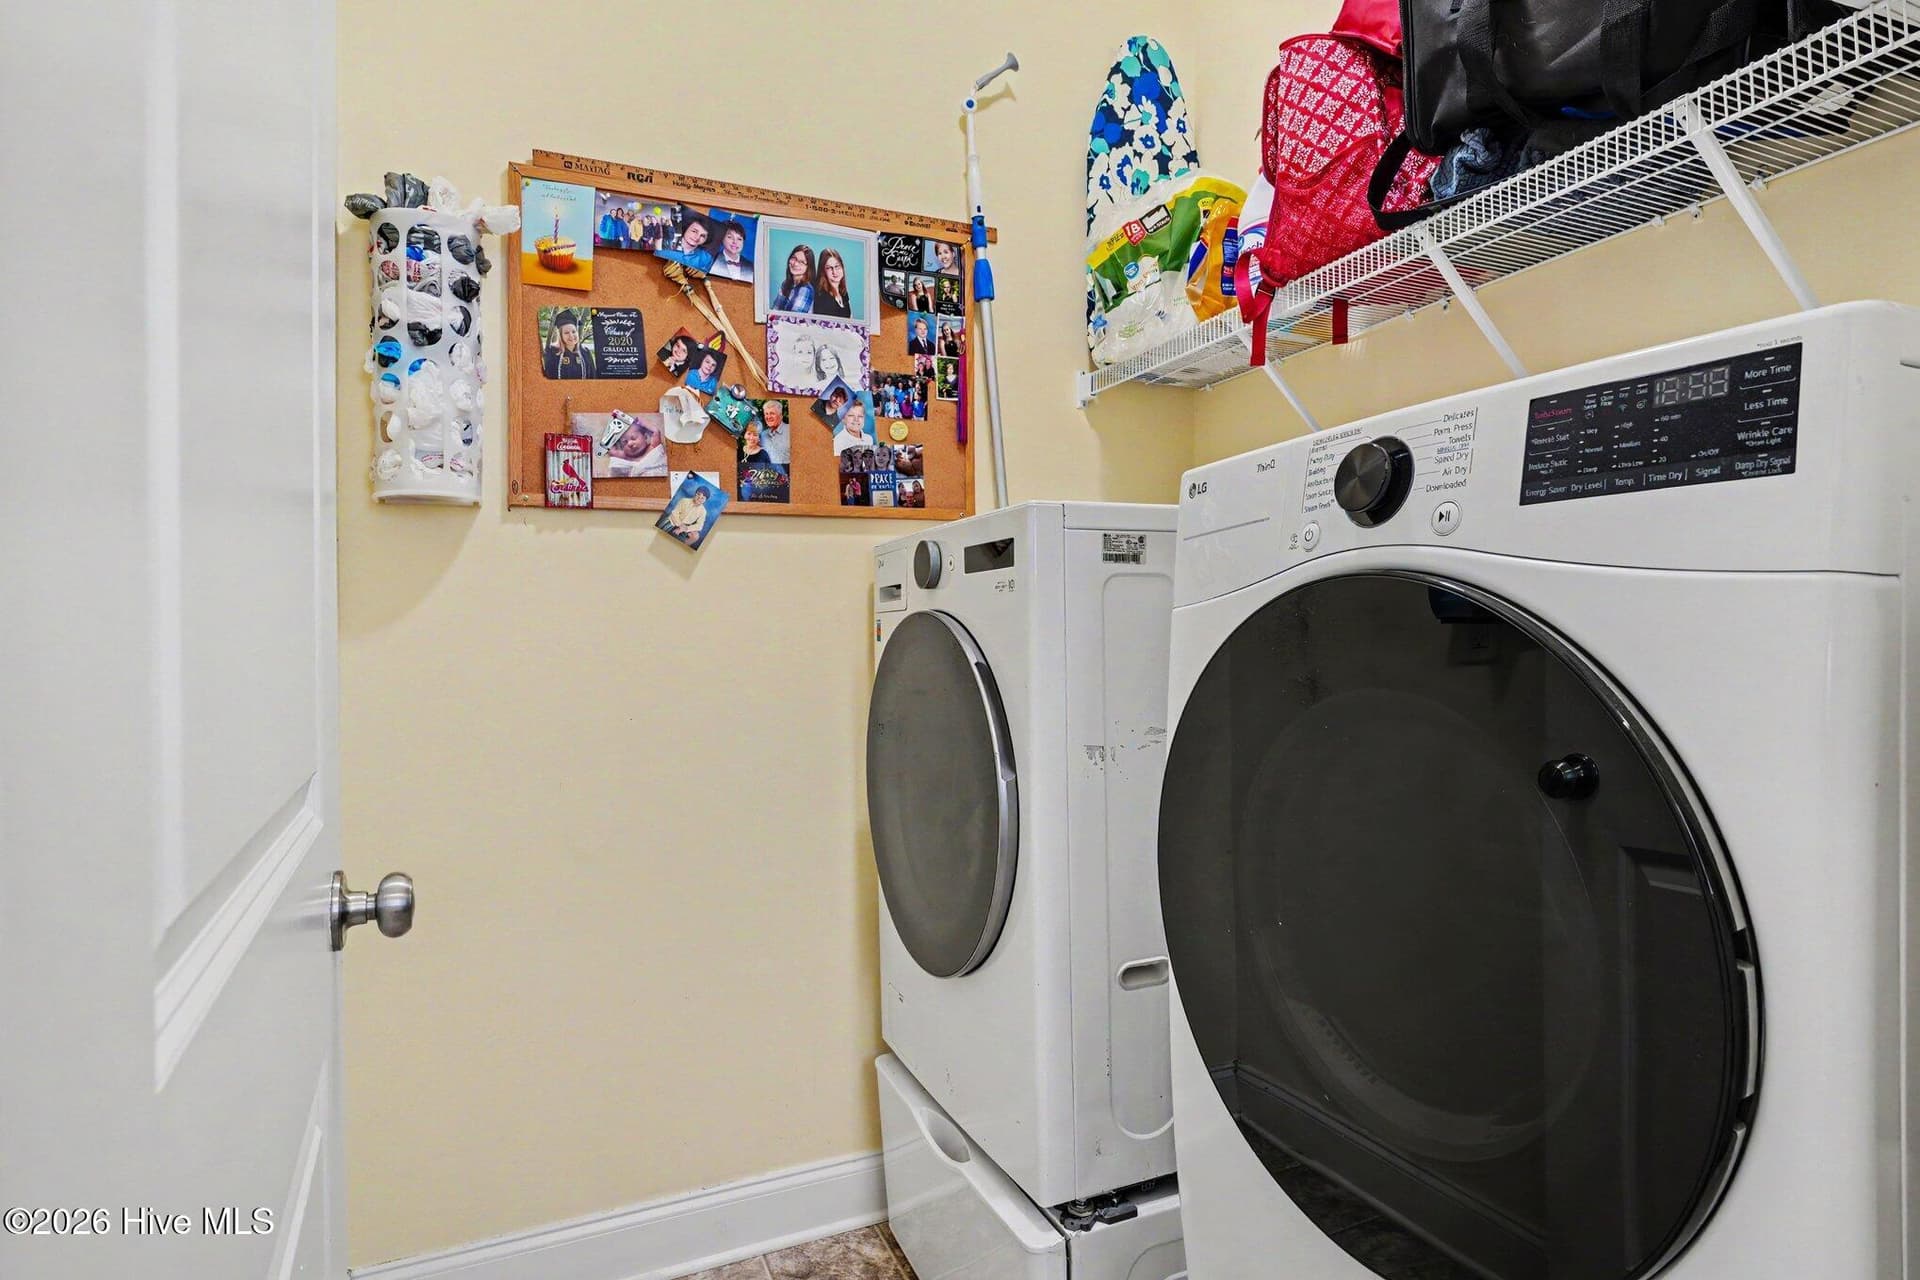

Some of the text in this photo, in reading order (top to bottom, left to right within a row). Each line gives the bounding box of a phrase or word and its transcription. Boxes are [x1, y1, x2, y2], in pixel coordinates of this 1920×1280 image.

[574, 161, 611, 175] MAYTAG
[627, 171, 654, 184] RCA
[608, 336, 633, 346] 2020
[1744, 364, 1792, 379] More Time
[1744, 396, 1789, 411] Less Time
[1443, 410, 1474, 422] Delicates
[1454, 422, 1473, 432] Press
[1736, 426, 1793, 440] Wrinkle Care
[1449, 434, 1472, 445] Towels
[1555, 433, 1571, 443] Start
[1434, 451, 1470, 464] Speed Dry
[1735, 456, 1791, 471] Damp Dry Signal
[1256, 459, 1276, 472] ThinQ
[1442, 465, 1467, 477] Air Dry
[1696, 465, 1721, 477] Signal
[870, 473, 893, 484] PEACE
[1648, 471, 1683, 482] Time Dry
[1426, 479, 1467, 493] Downloaded
[1525, 485, 1566, 497] Energy Saver
[1571, 480, 1603, 492] Dry Level
